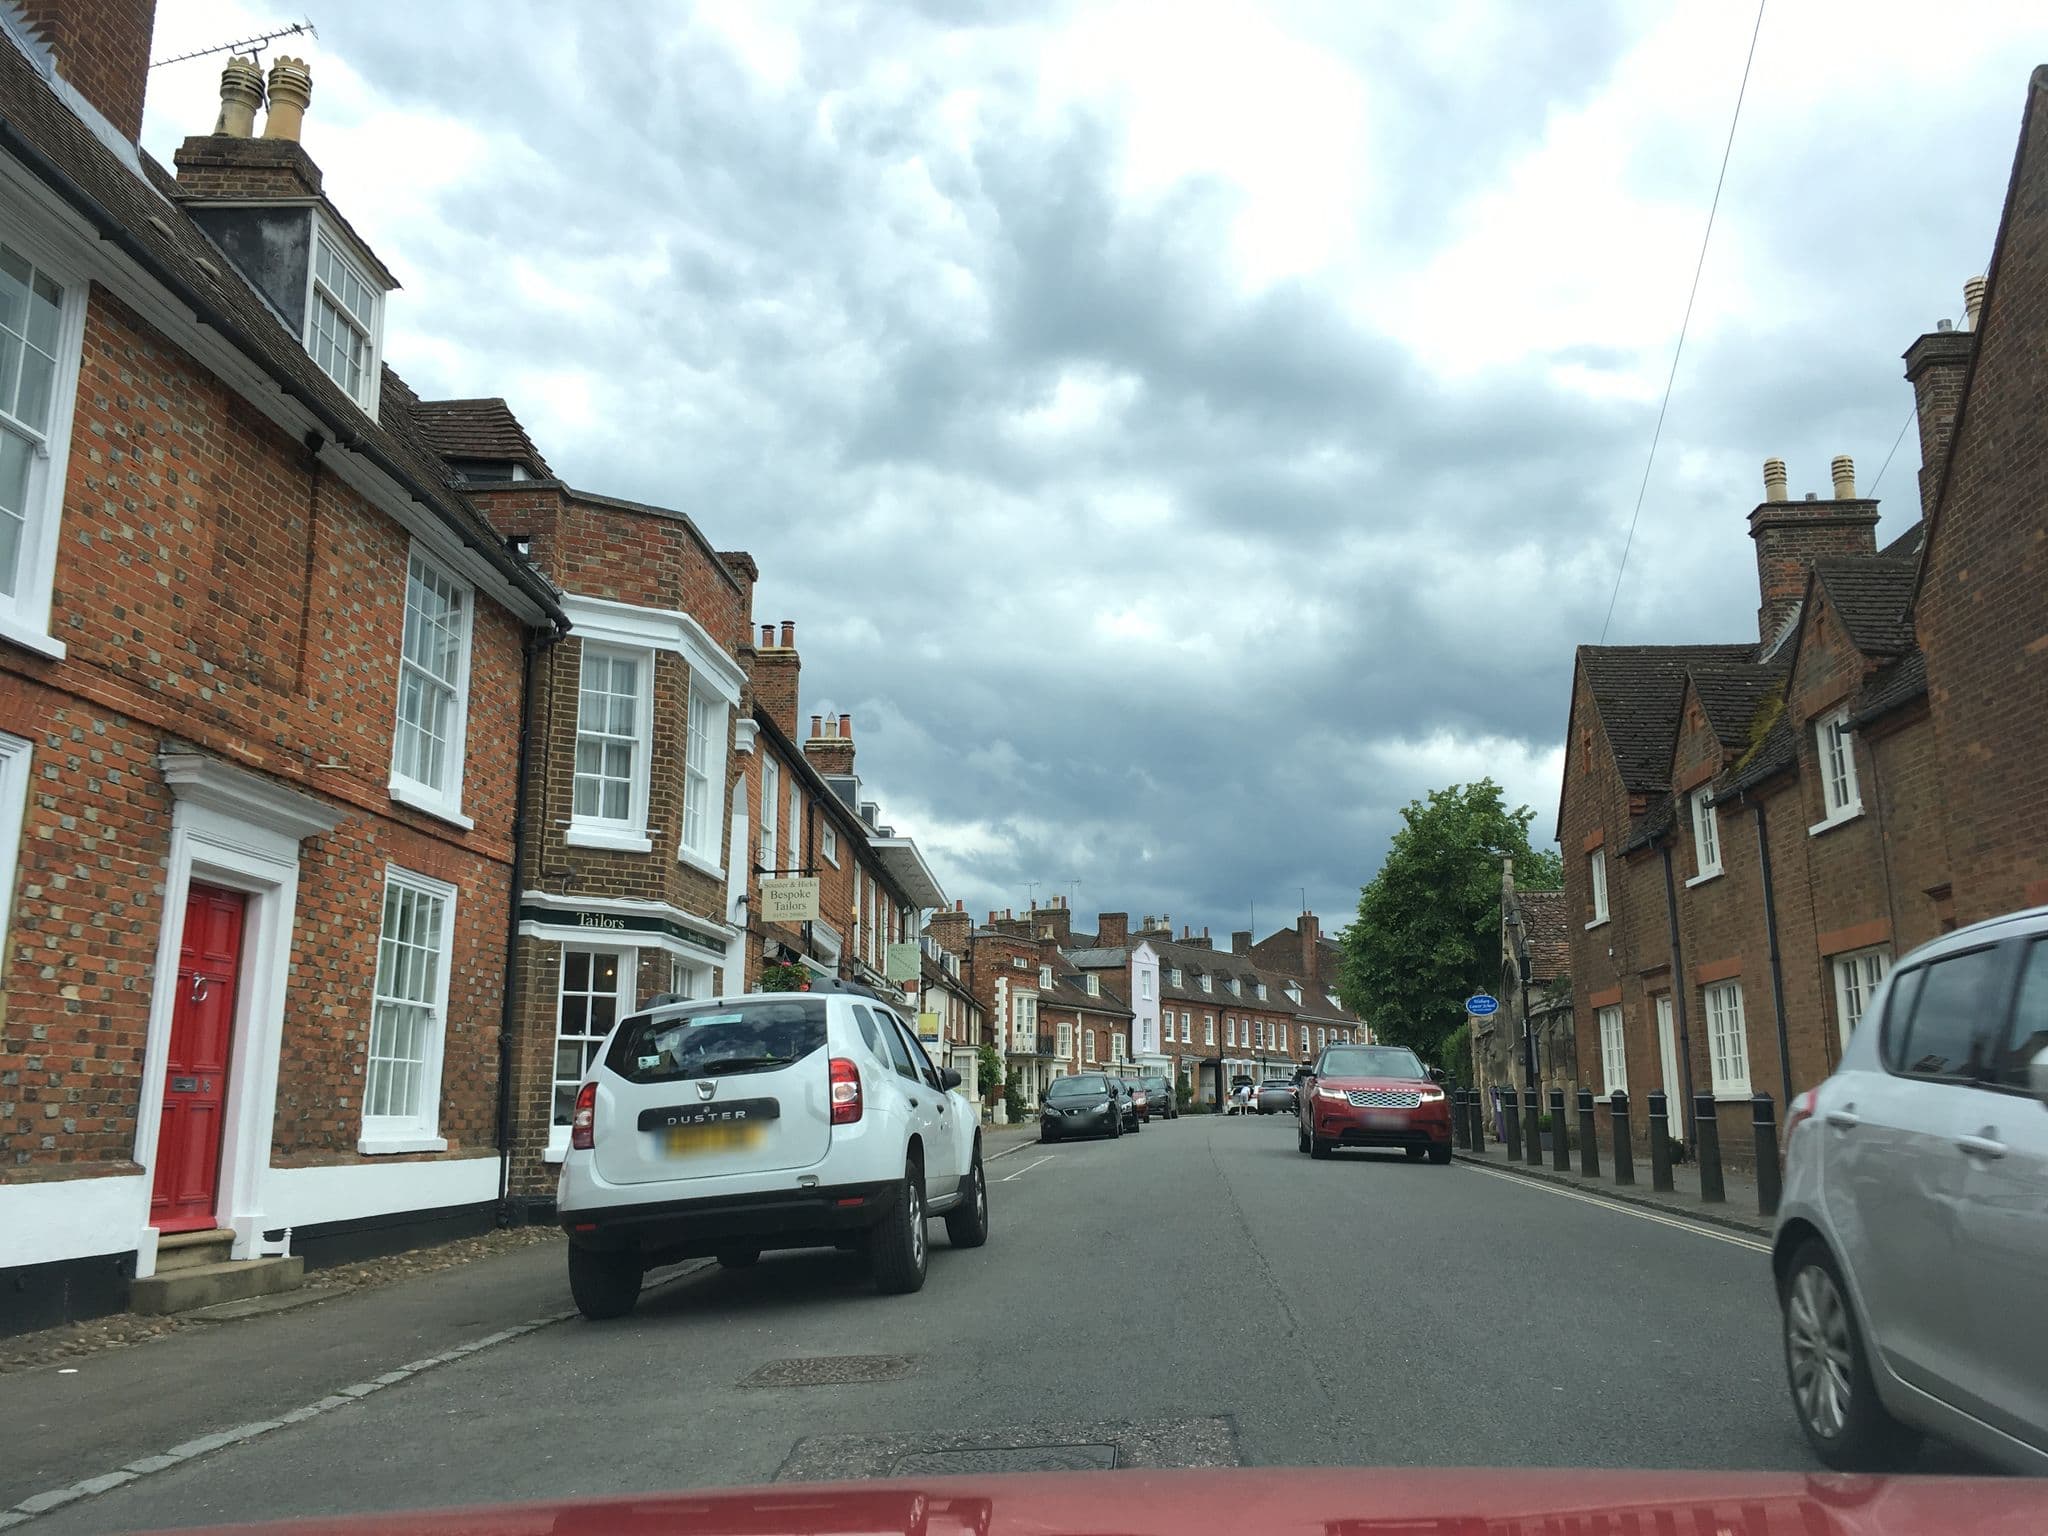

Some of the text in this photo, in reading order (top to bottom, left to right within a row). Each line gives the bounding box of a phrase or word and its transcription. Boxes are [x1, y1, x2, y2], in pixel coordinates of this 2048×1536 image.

[770, 889, 811, 901] Bespoke
[774, 901, 807, 911] Tailors
[575, 911, 625, 929] Tailors
[667, 1110, 747, 1126] DUSTER
